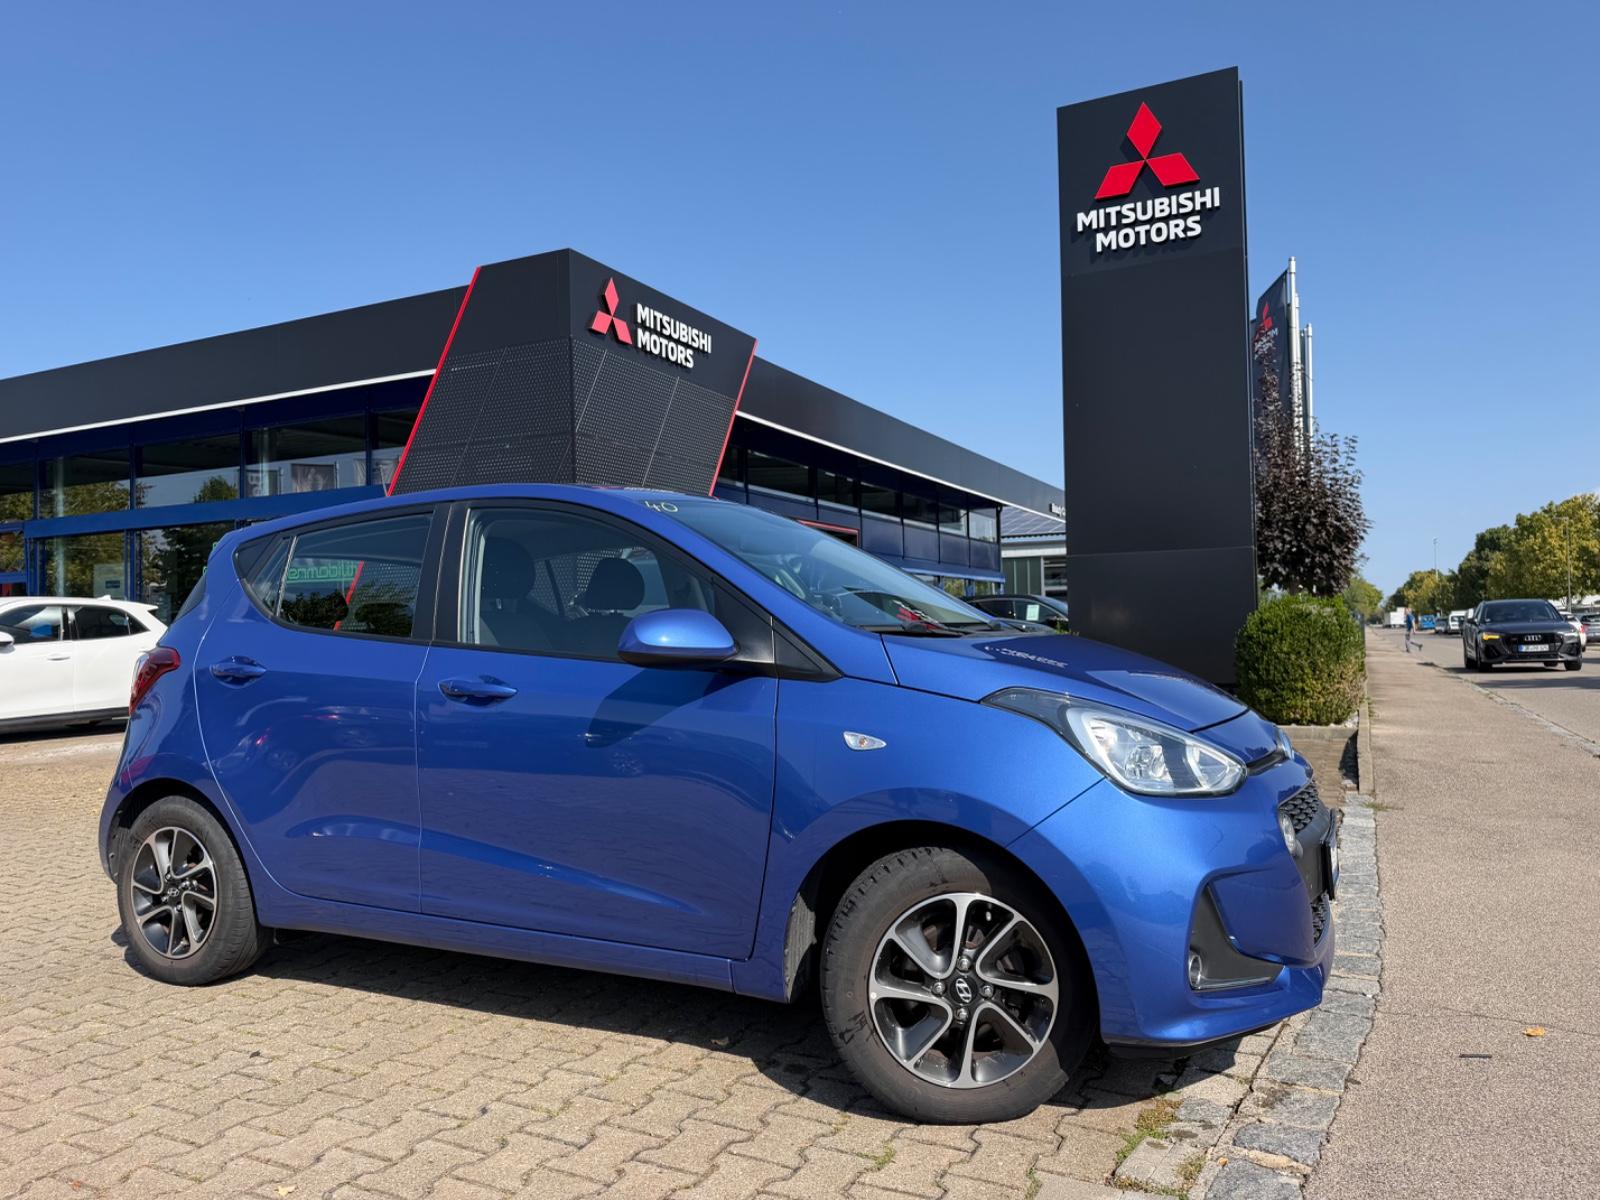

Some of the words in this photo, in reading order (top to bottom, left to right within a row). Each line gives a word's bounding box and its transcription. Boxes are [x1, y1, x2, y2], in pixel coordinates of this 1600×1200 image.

[1077, 187, 1220, 232] MITSUBISHI
[1096, 216, 1202, 252] MOTORS
[636, 303, 712, 353] MITSUBISHI
[637, 328, 695, 369] MOTORS
[644, 501, 678, 512] 40
